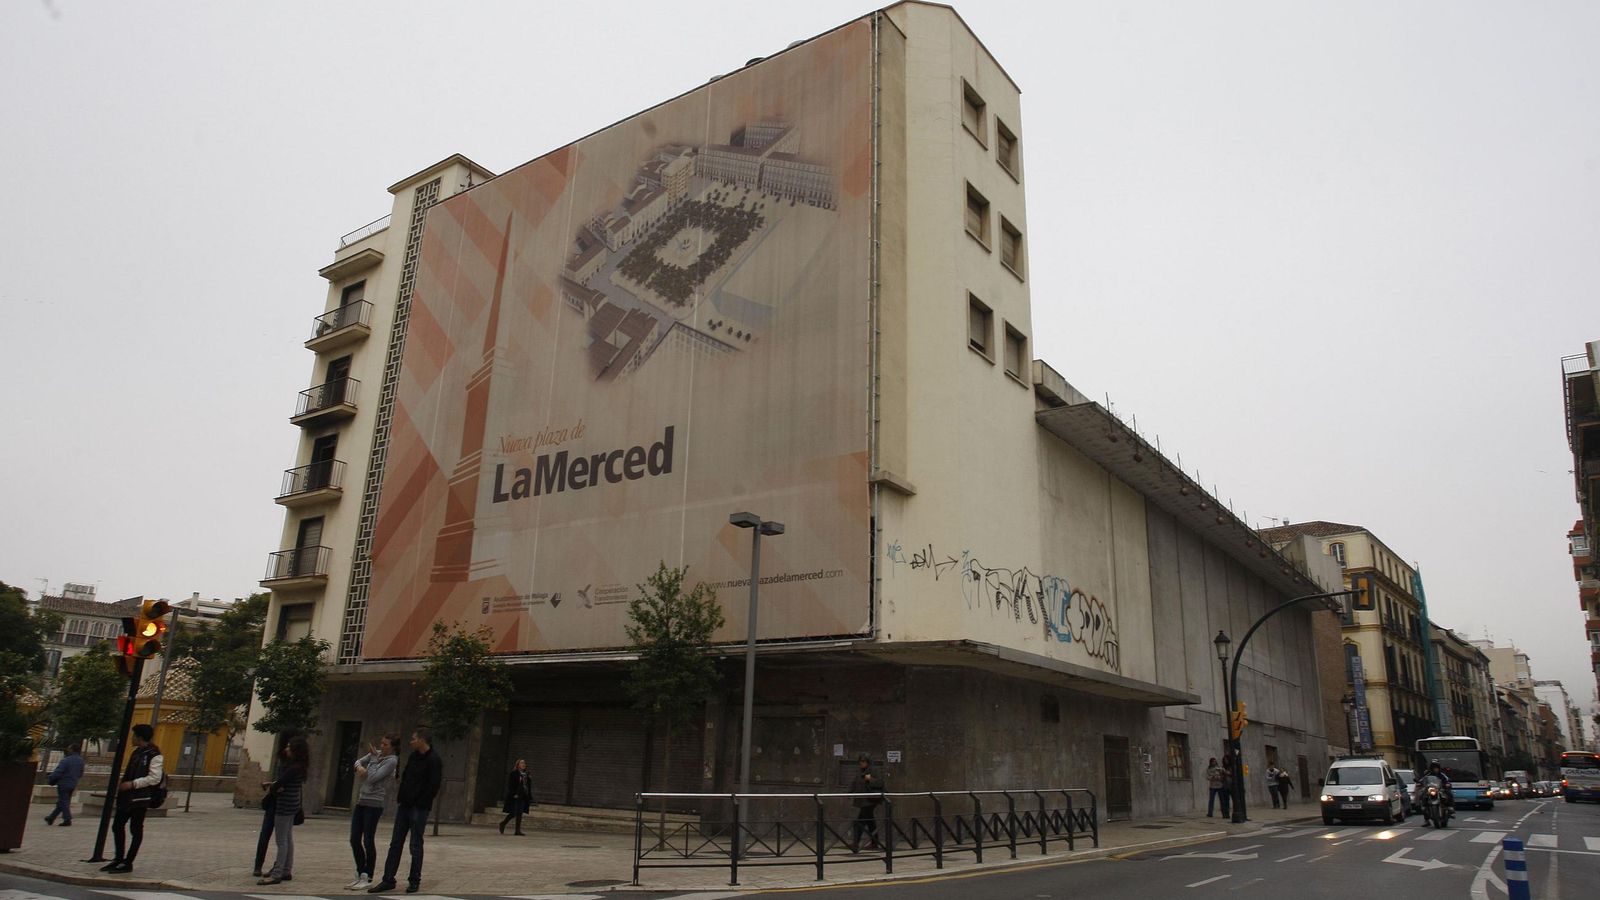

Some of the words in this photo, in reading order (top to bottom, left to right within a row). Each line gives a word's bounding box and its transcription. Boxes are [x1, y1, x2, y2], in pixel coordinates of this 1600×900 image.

[499, 434, 532, 455] Nueva
[533, 426, 569, 454] plaza
[570, 419, 586, 440] de
[492, 425, 675, 504] LaMerced
[707, 568, 844, 590] www.nuevaazadelamerced.com
